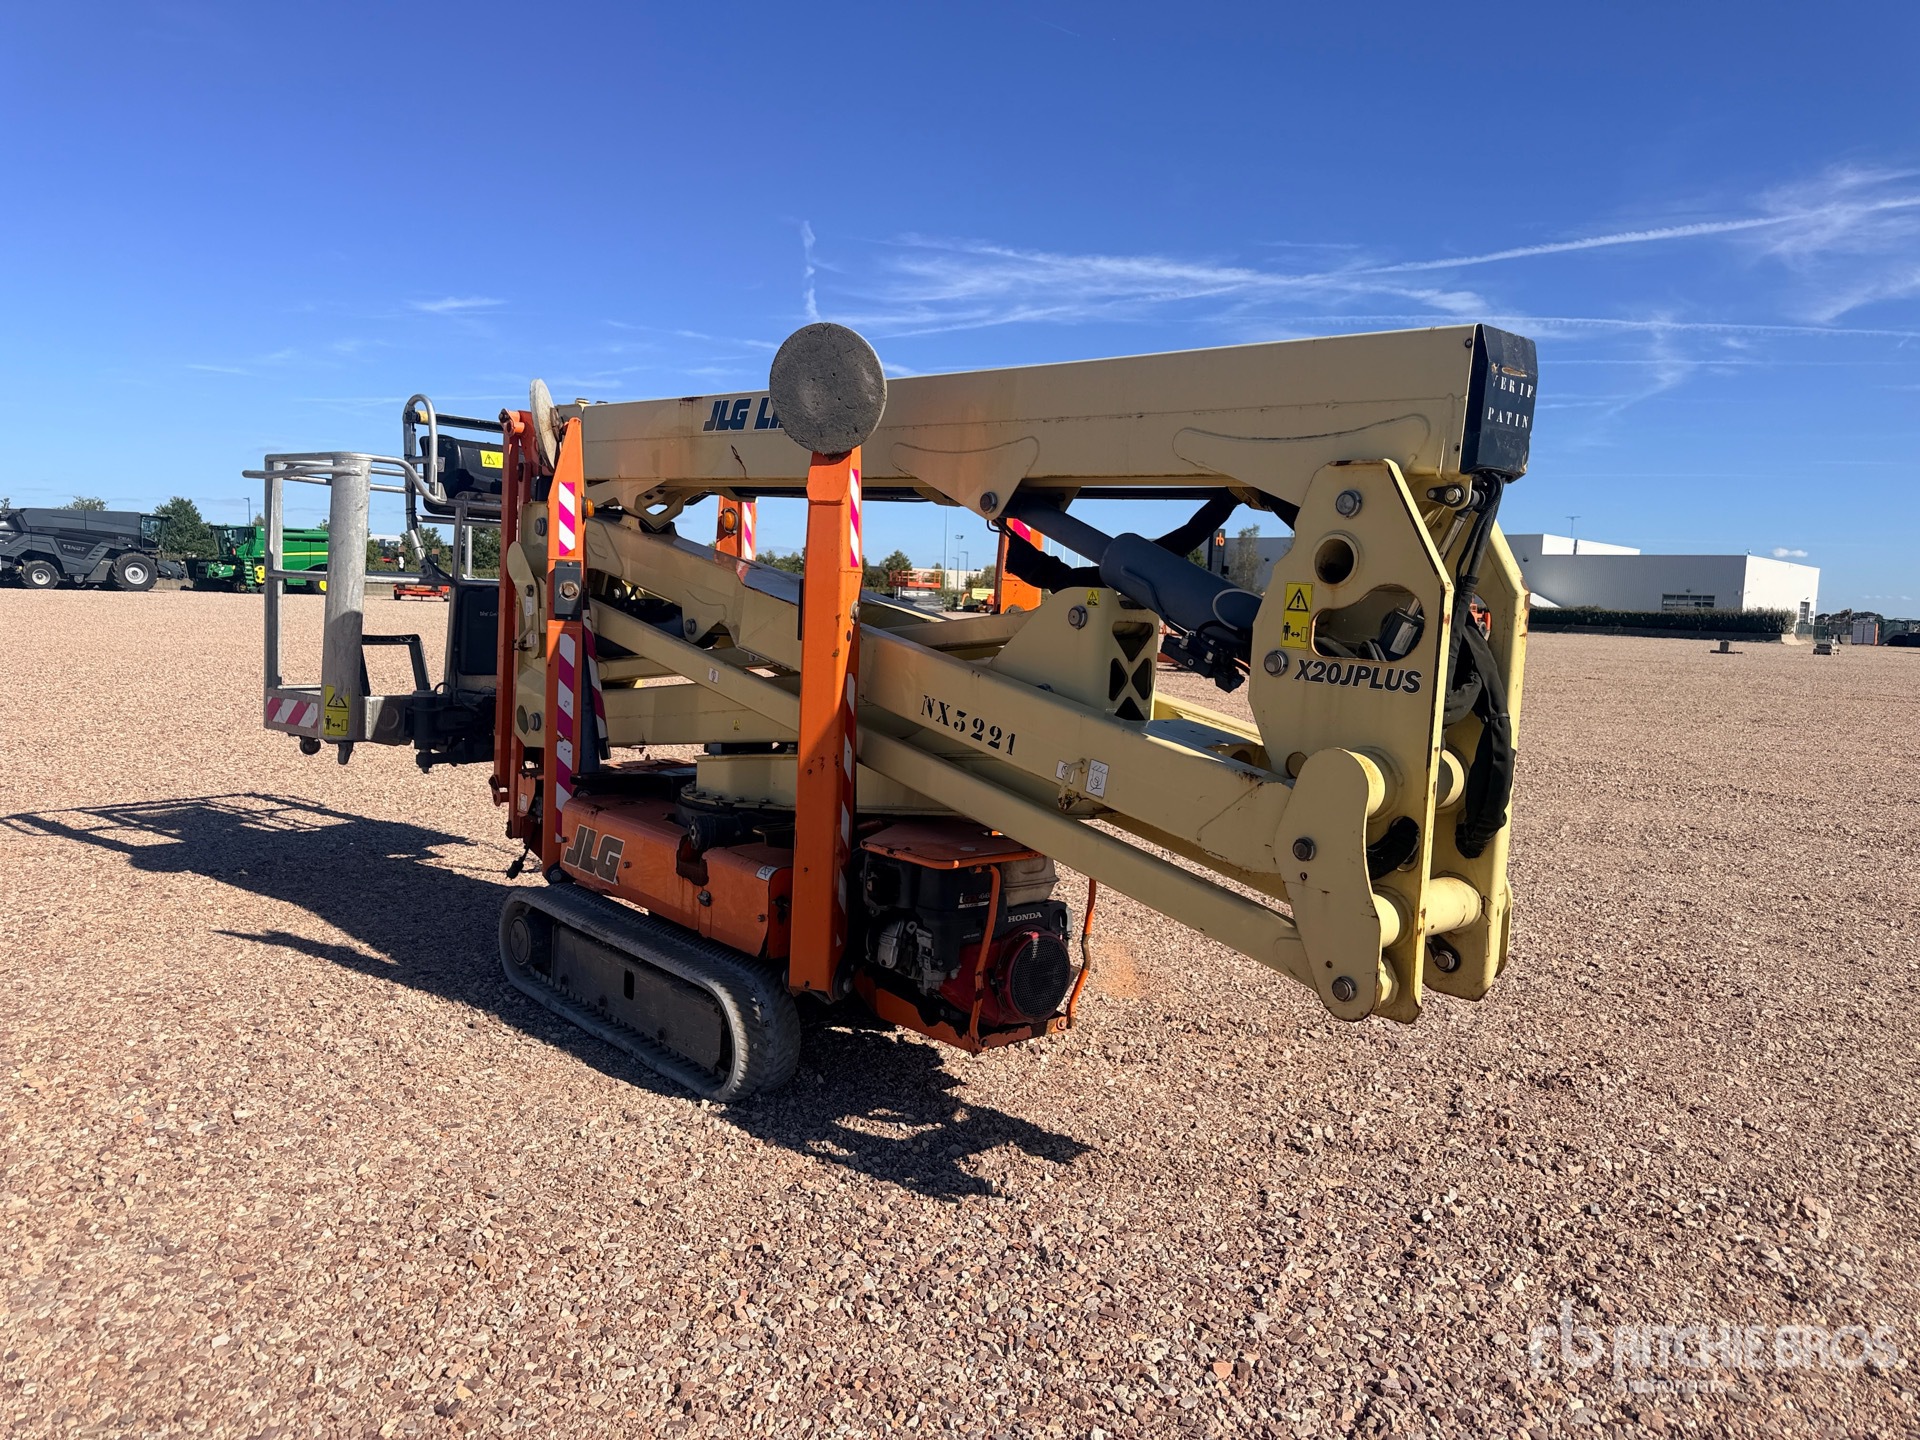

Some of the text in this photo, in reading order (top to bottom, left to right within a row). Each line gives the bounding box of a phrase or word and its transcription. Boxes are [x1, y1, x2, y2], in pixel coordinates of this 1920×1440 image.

[702, 398, 752, 432] JLG
[1487, 406, 1529, 429] PATIN
[1294, 659, 1423, 694] X20JPLUS
[920, 694, 1016, 756] NX3221
[562, 823, 626, 885] JLG
[1007, 911, 1042, 923] HONDA
